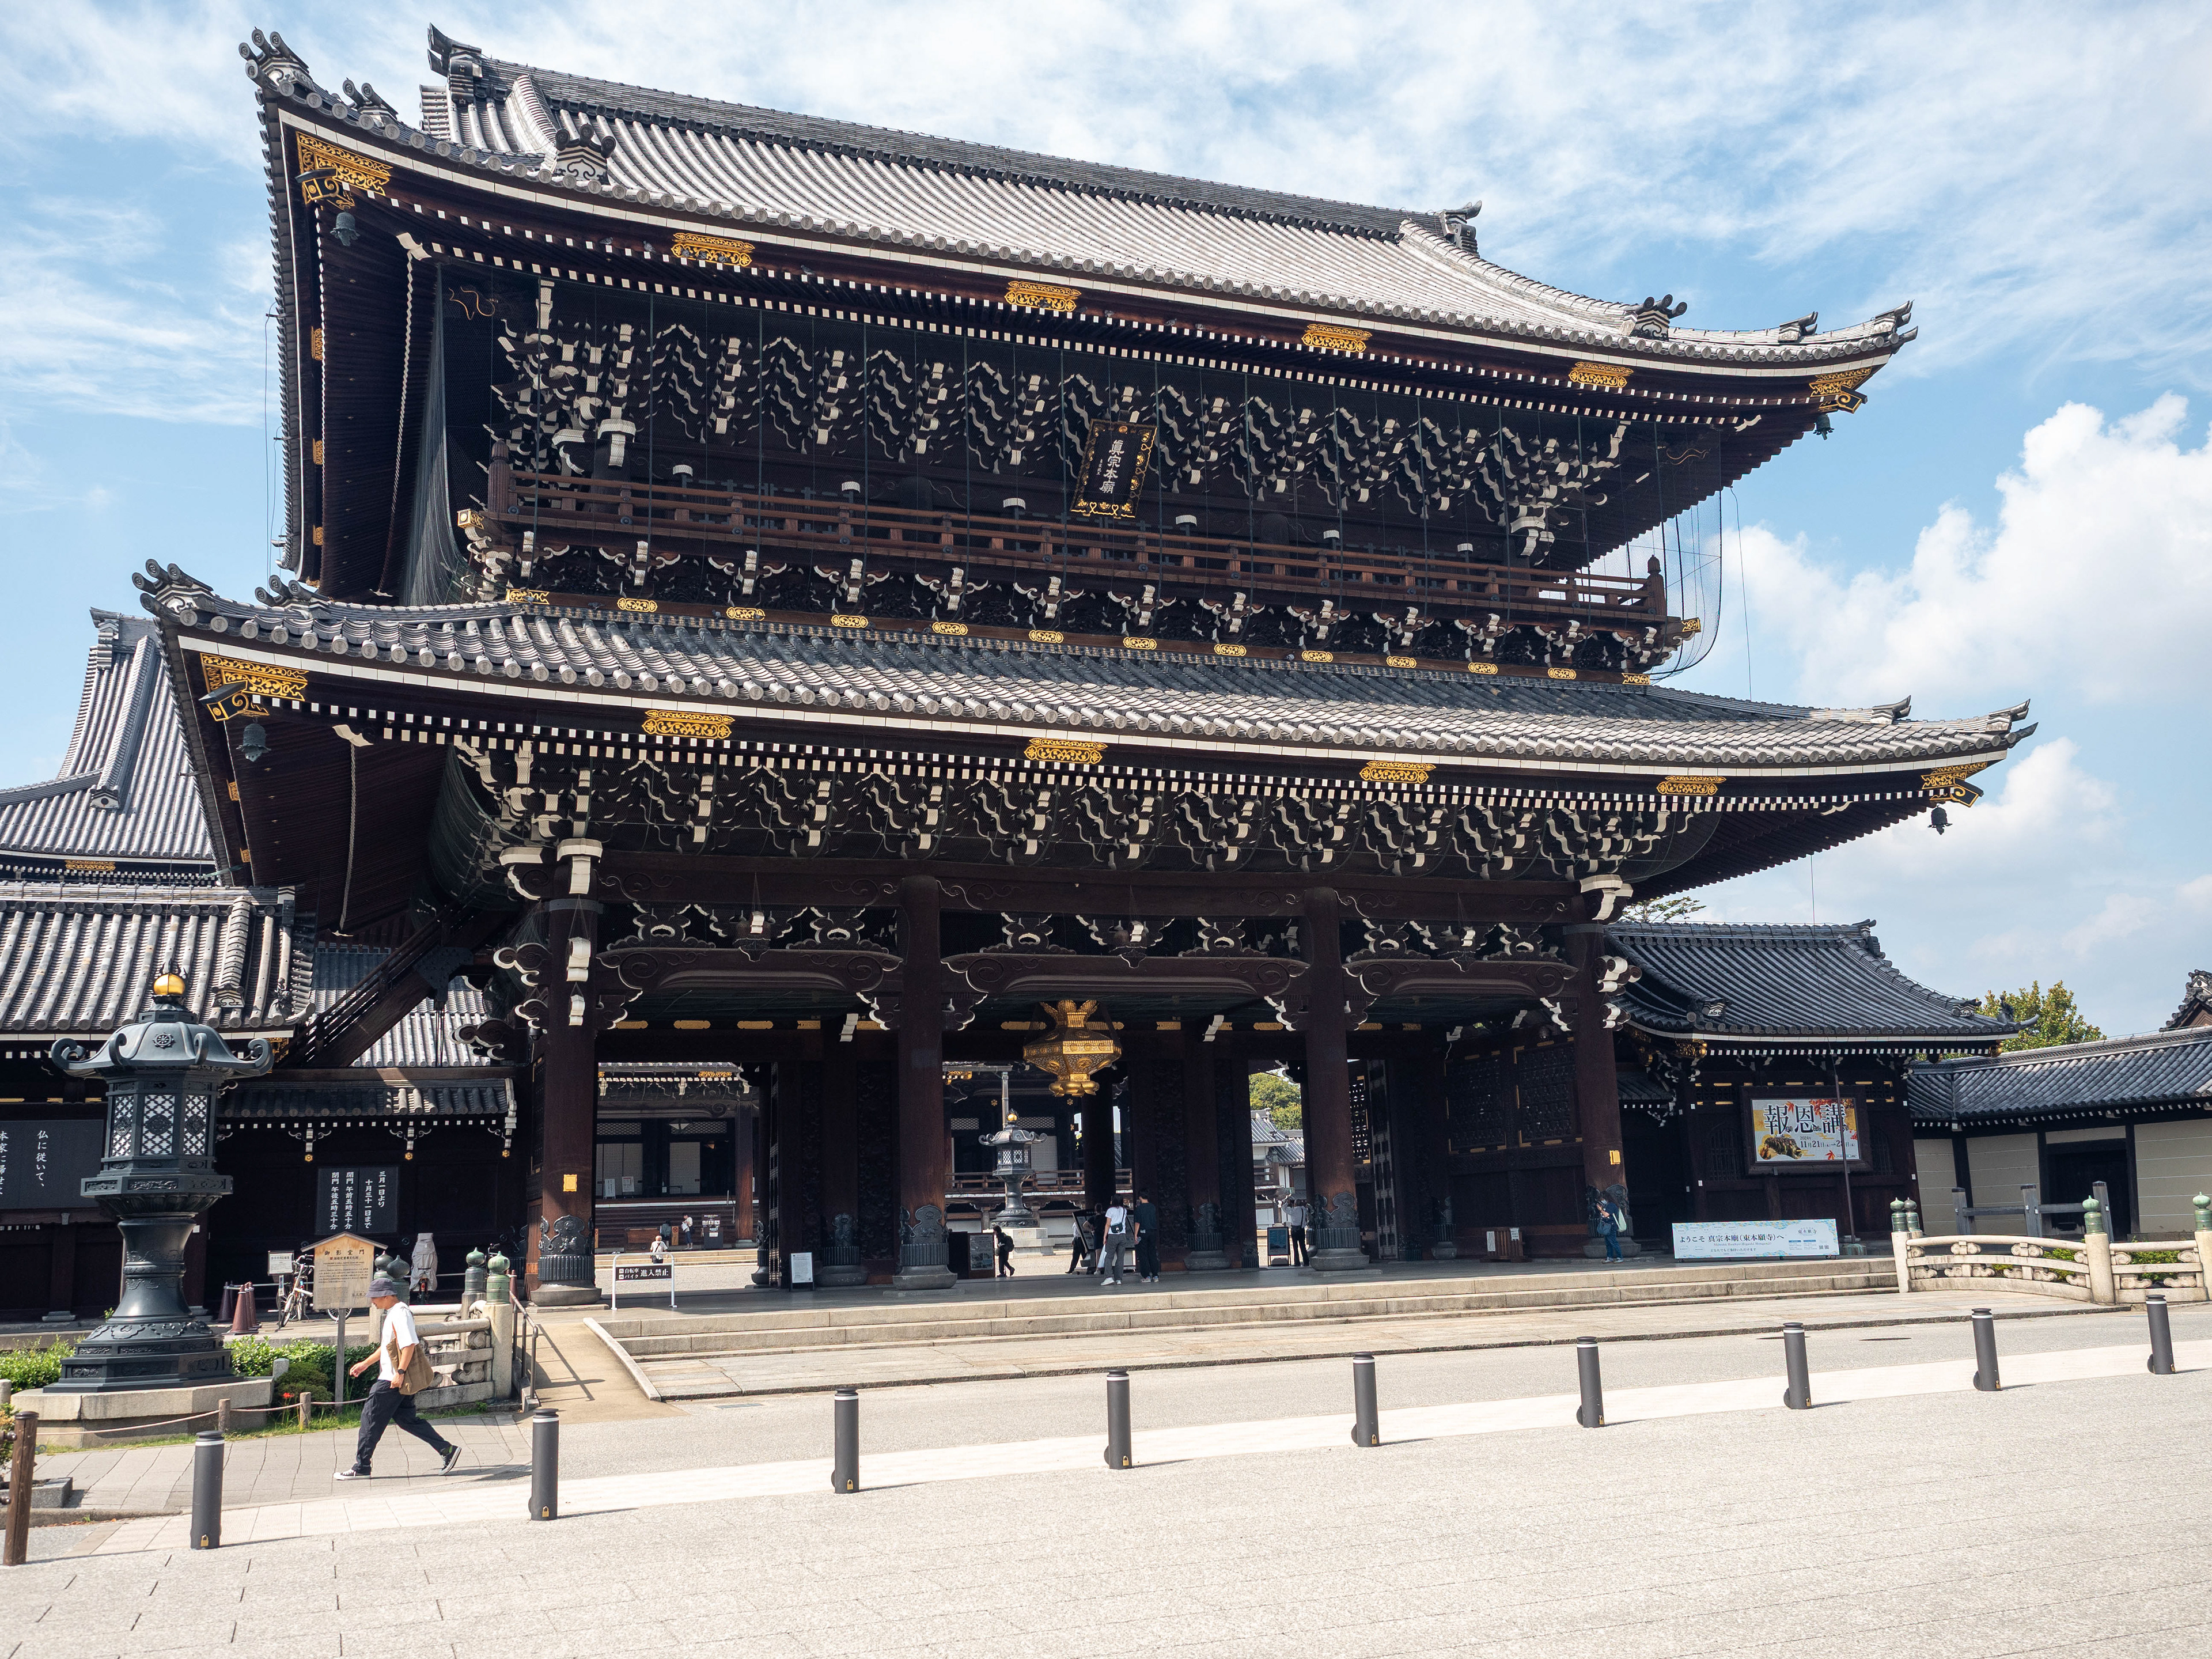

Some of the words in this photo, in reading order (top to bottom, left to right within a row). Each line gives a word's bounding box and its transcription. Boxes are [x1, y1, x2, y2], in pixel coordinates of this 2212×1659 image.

[1764, 1103, 1846, 1135] 報恩講
[36, 1130, 48, 1187] 仏に従いて、
[329, 1187, 339, 1230] 午後五時三十分
[344, 1186, 353, 1229] 午前五時五十分
[364, 1179, 373, 1228] 十月三十一日まで
[378, 1171, 386, 1207] 三月一日より
[640, 1268, 669, 1277] 進入禁止
